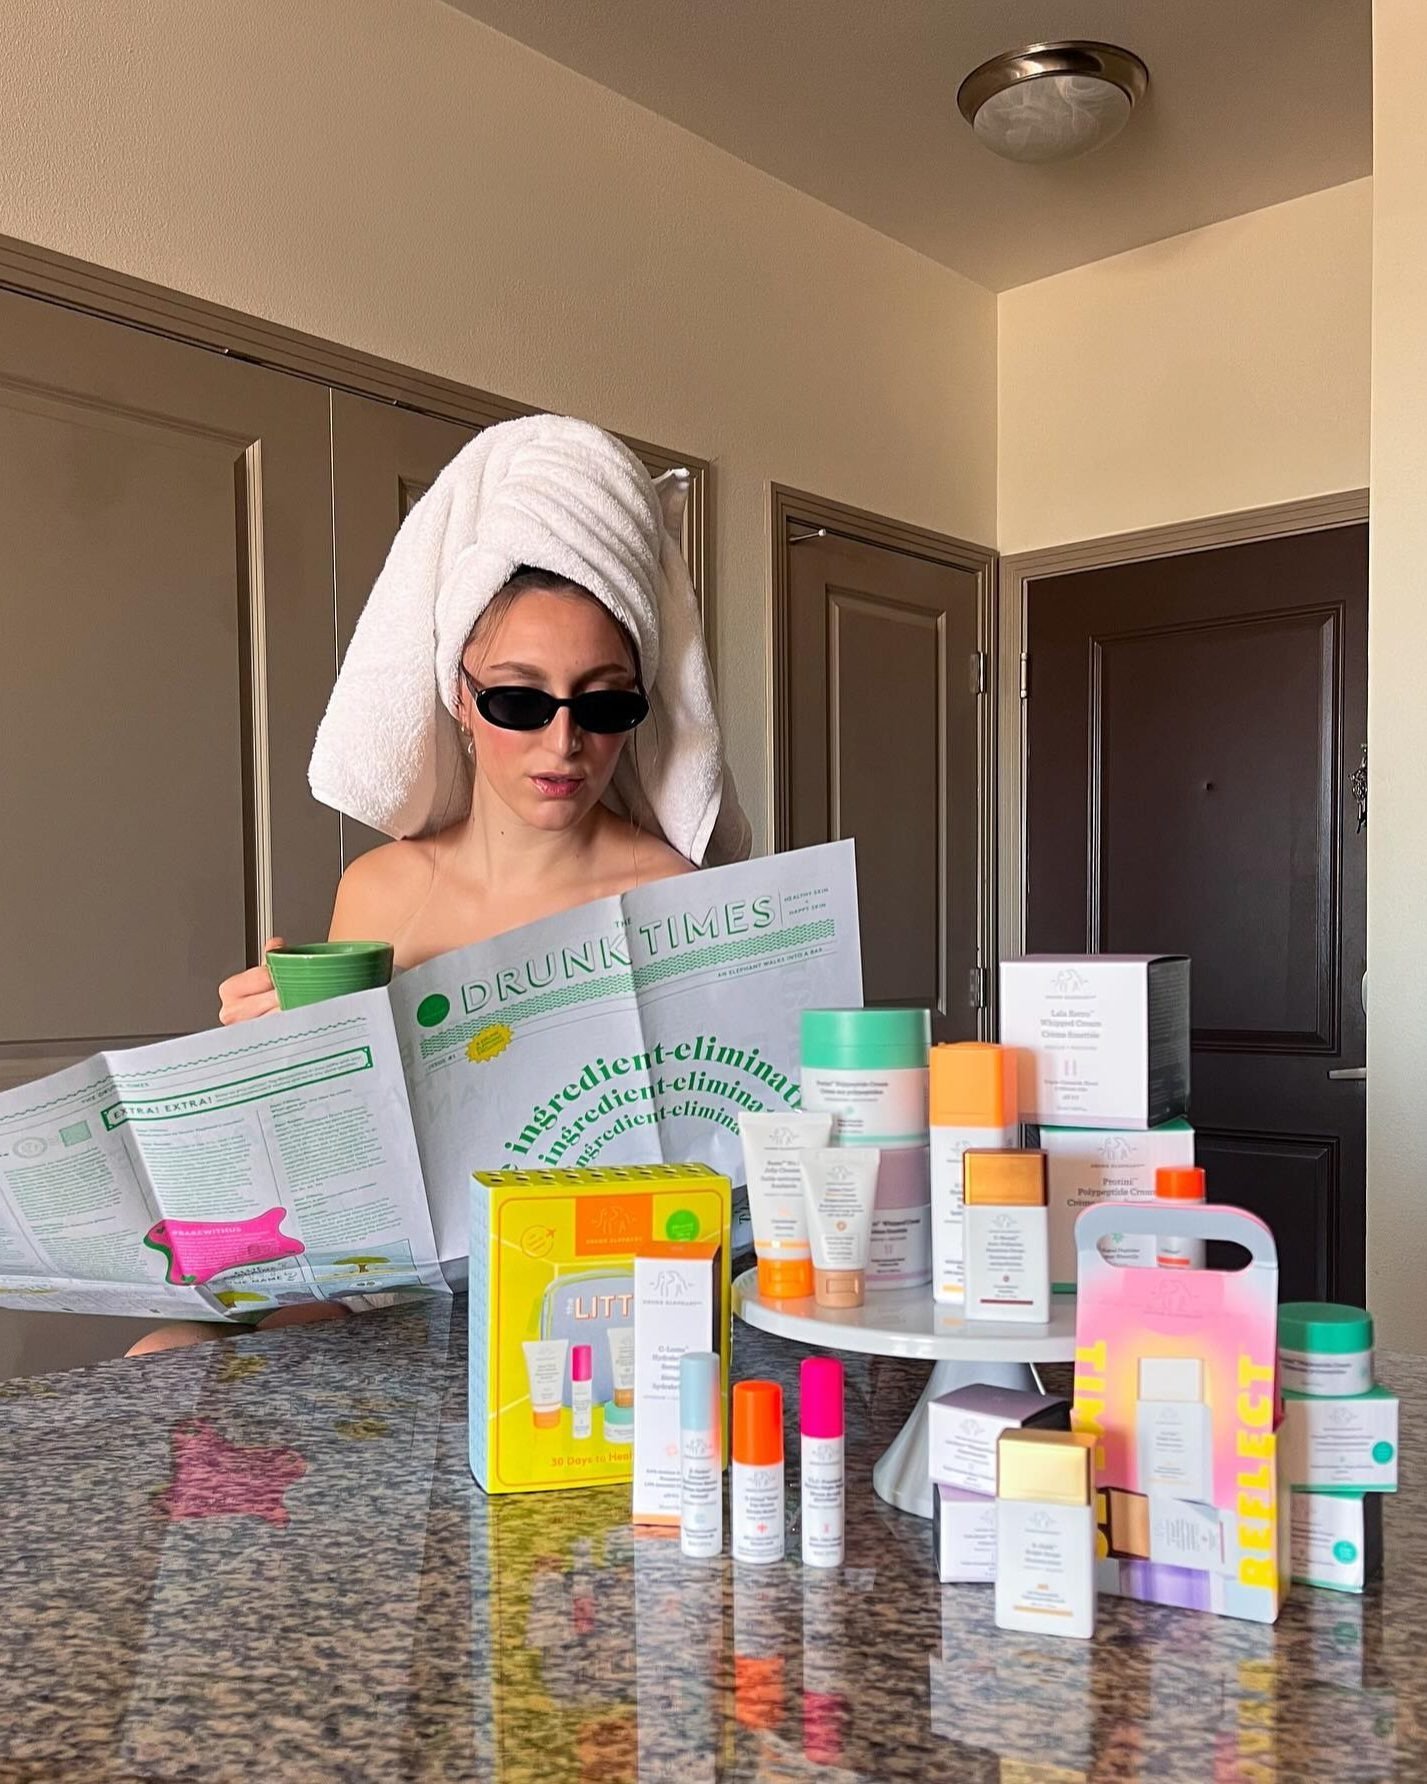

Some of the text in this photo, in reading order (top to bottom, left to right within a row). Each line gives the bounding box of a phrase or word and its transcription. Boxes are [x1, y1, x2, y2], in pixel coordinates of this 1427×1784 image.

[614, 917, 632, 928] THE
[461, 895, 776, 1015] DRUNK TIMES
[729, 962, 762, 976] ELEPHANT
[763, 957, 786, 968] WALKS
[786, 953, 803, 963] INTO
[113, 1096, 213, 1120] EXTRA! EXTRA!
[538, 1071, 775, 1167] ingredient-elimina
[567, 1101, 741, 1168] ngredient-elimina
[1078, 1187, 1128, 1198] Polypeptide
[551, 1456, 564, 1467] 30
[566, 1455, 592, 1467] Days
[1236, 1354, 1279, 1590] REFLECT
